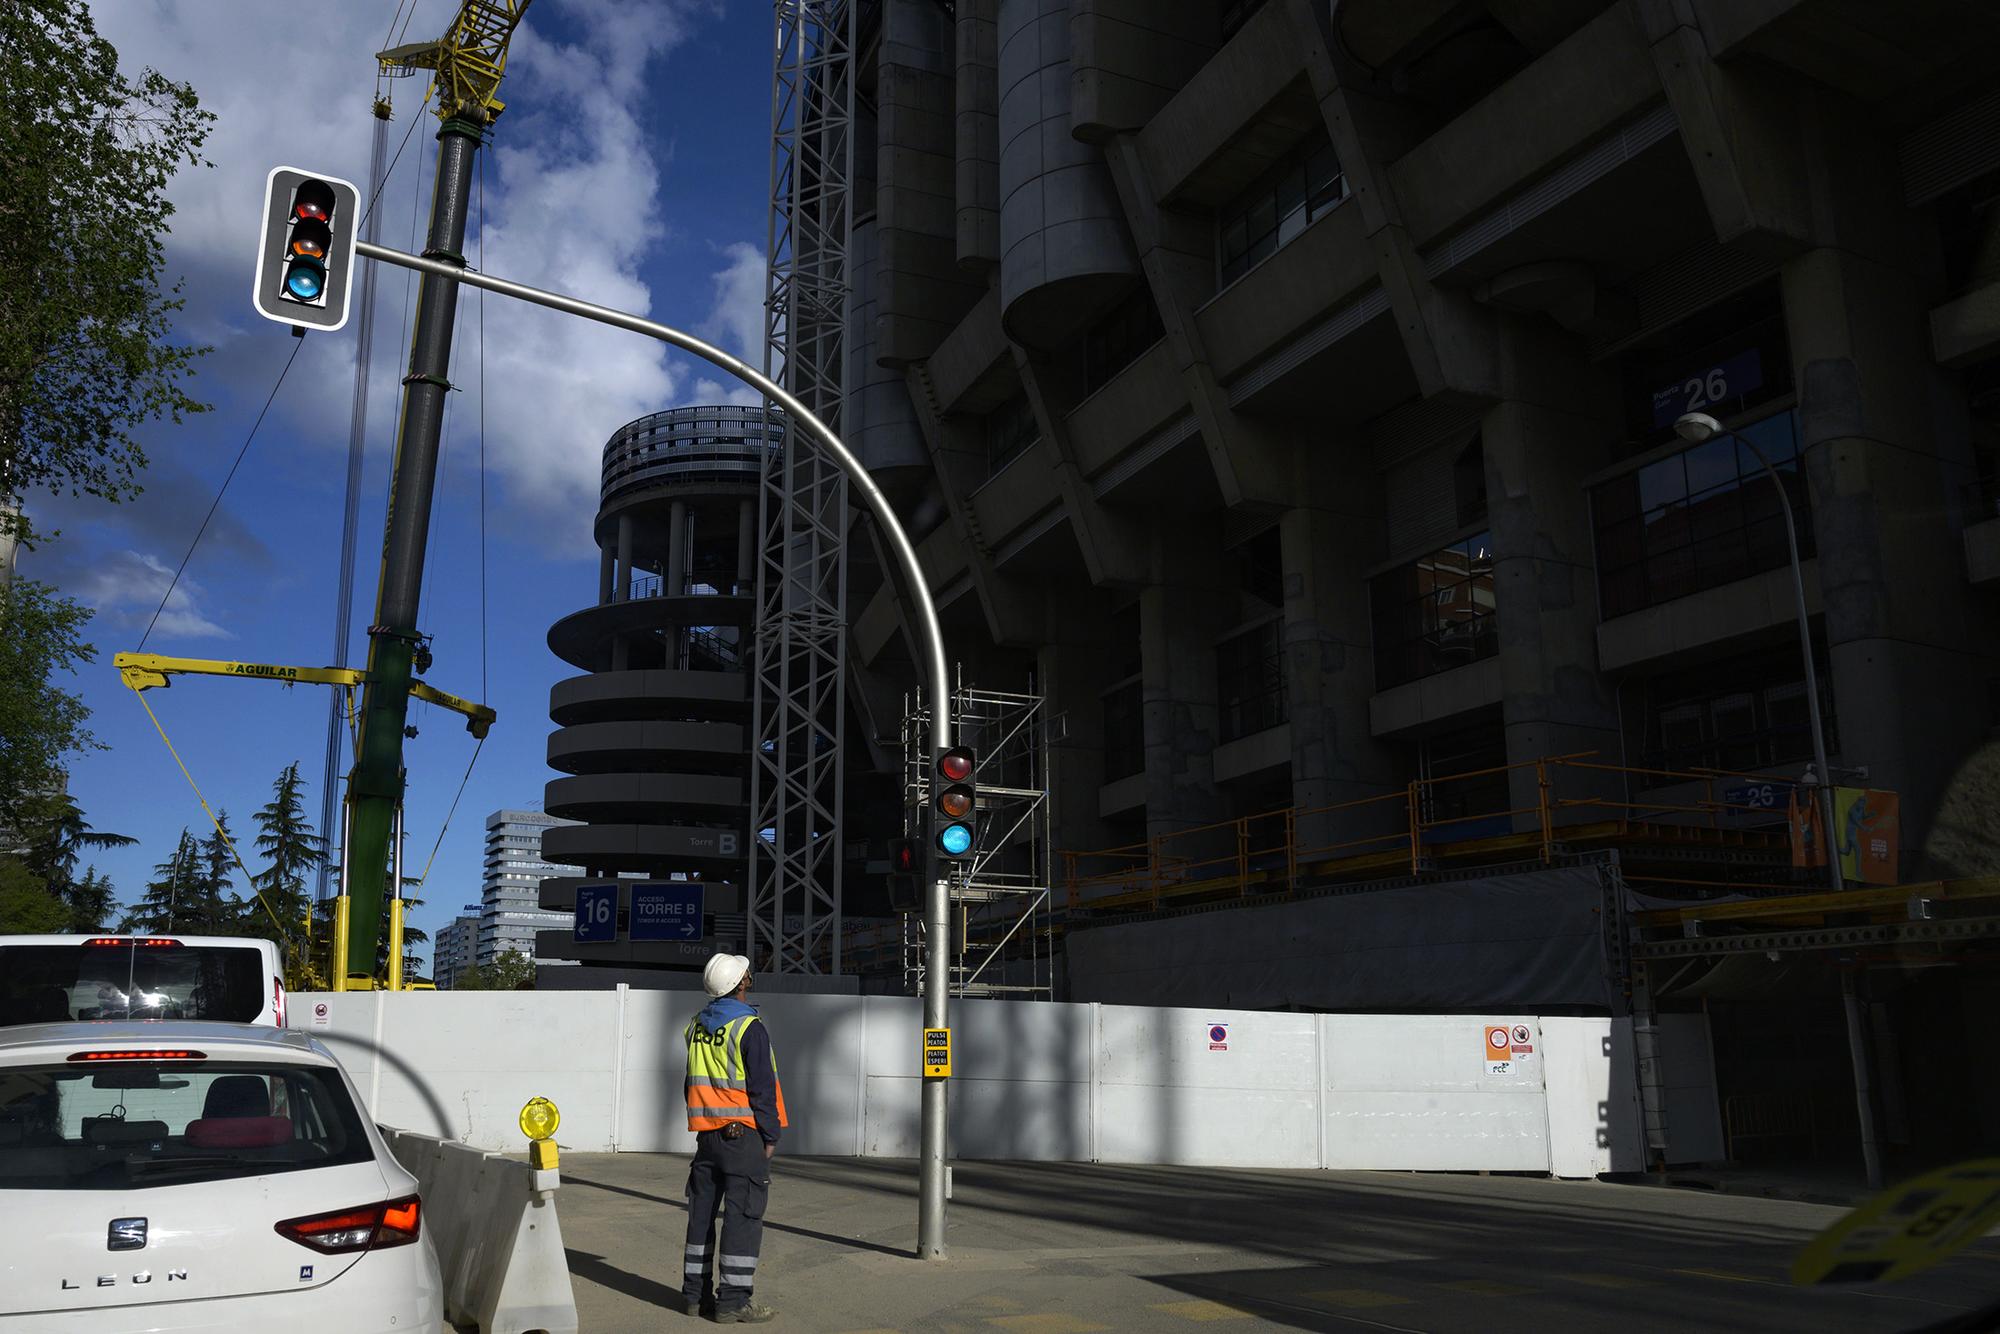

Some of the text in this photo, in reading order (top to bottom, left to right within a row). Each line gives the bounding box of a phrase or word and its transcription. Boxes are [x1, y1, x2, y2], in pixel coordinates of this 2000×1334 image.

[1683, 368, 1728, 413] 26
[235, 664, 297, 678] AGUILAR
[1747, 785, 1775, 808] 26
[688, 834, 737, 855] Torre B
[638, 895, 665, 903] ACCESO
[638, 903, 697, 915] TORRE B
[584, 898, 610, 924] 16
[680, 942, 710, 956] Torre
[61, 1267, 188, 1291] LEON
